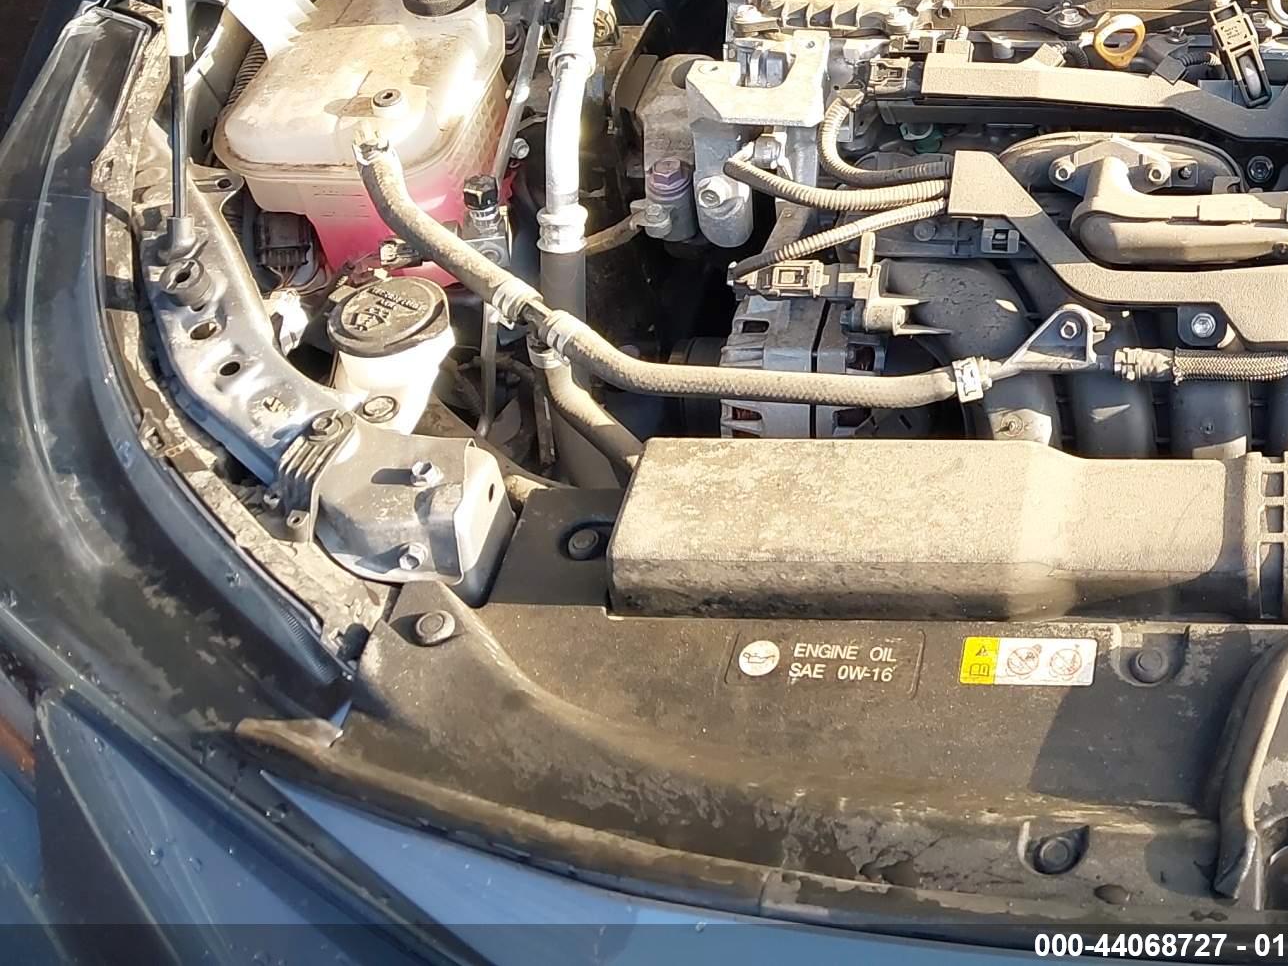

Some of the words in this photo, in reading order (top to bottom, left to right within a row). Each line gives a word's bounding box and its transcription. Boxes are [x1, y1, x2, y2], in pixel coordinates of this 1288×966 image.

[794, 643, 859, 660] ENGINE
[869, 646, 897, 662] OIL
[789, 662, 826, 679] SAE
[837, 664, 893, 682] 0W-16
